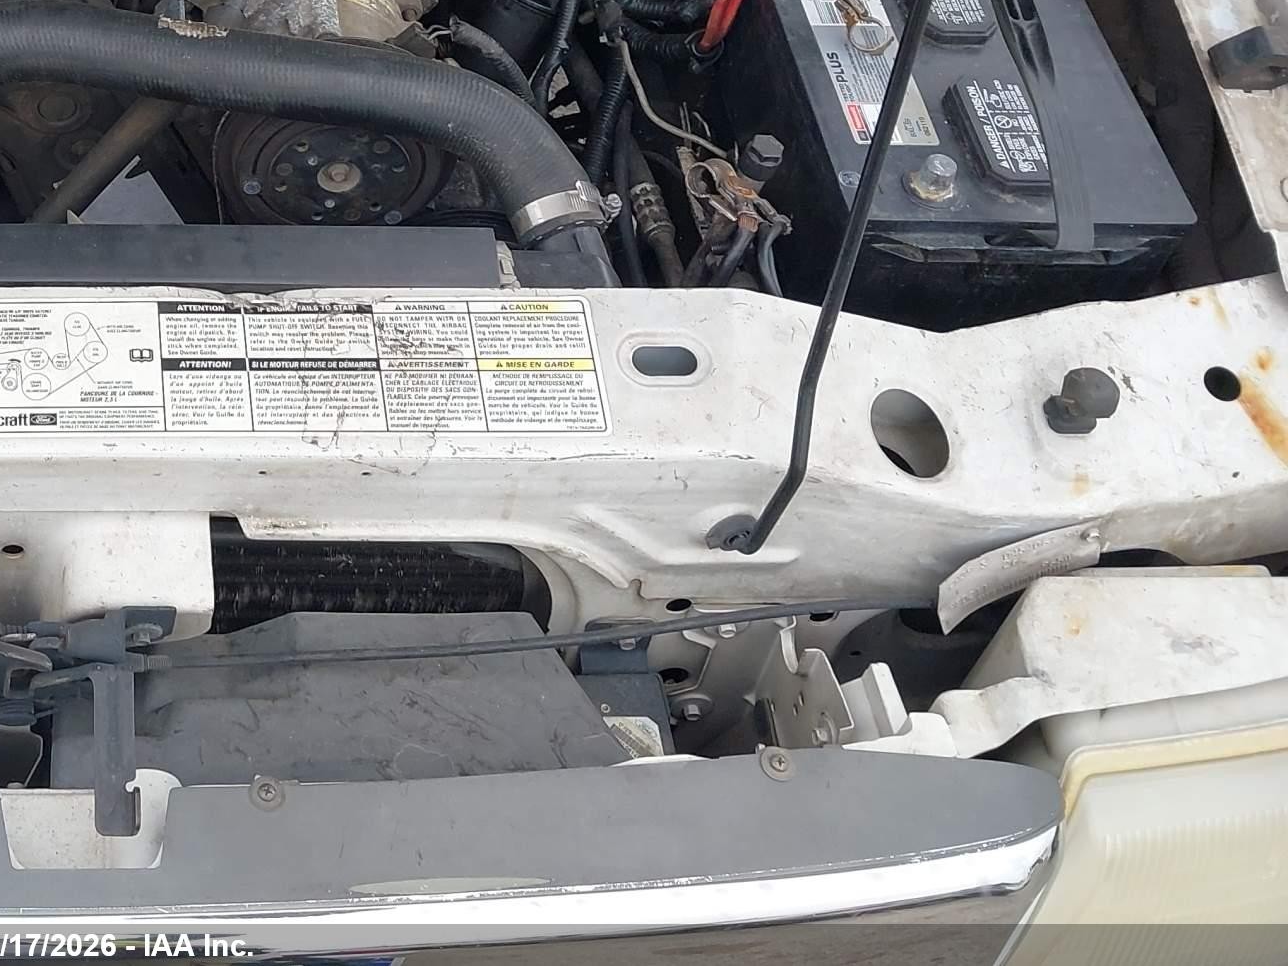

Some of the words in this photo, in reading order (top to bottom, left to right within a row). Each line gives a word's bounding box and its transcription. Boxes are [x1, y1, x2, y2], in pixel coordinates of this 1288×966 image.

[826, 52, 848, 82] PLUS
[966, 86, 987, 117] POISON
[984, 125, 1006, 160] DANGER
[338, 360, 376, 369] DÉMARRER
